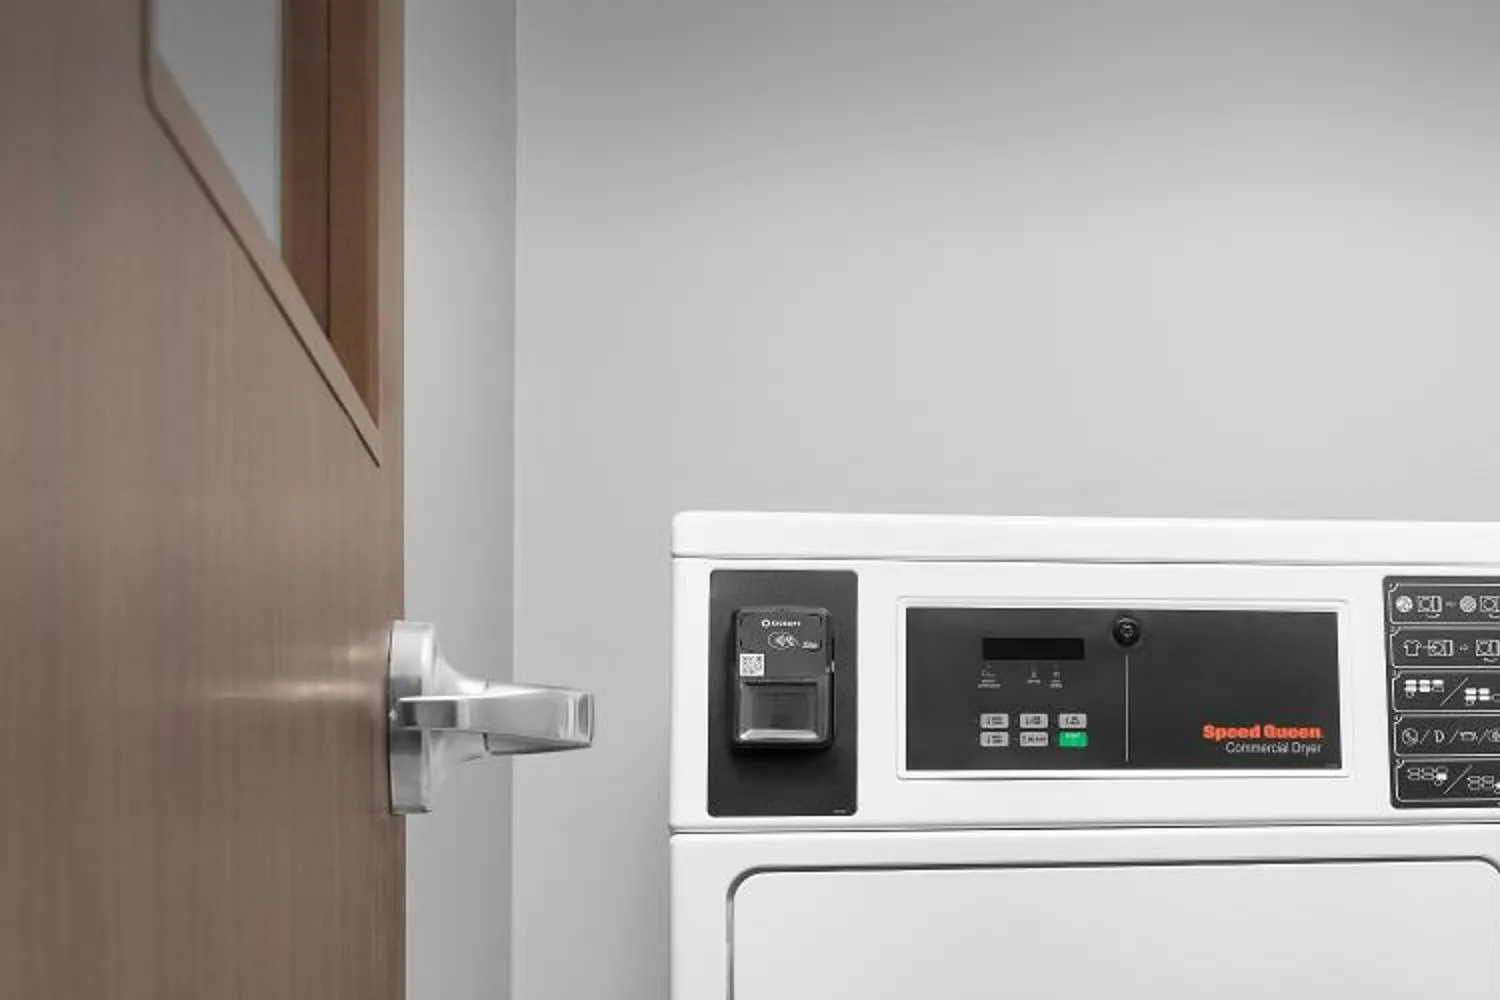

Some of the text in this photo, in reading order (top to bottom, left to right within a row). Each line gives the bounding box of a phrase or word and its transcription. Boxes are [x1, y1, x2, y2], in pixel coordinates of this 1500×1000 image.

[1203, 724, 1321, 741] Speed Queen
[1225, 741, 1321, 756] Commercial Dryer
